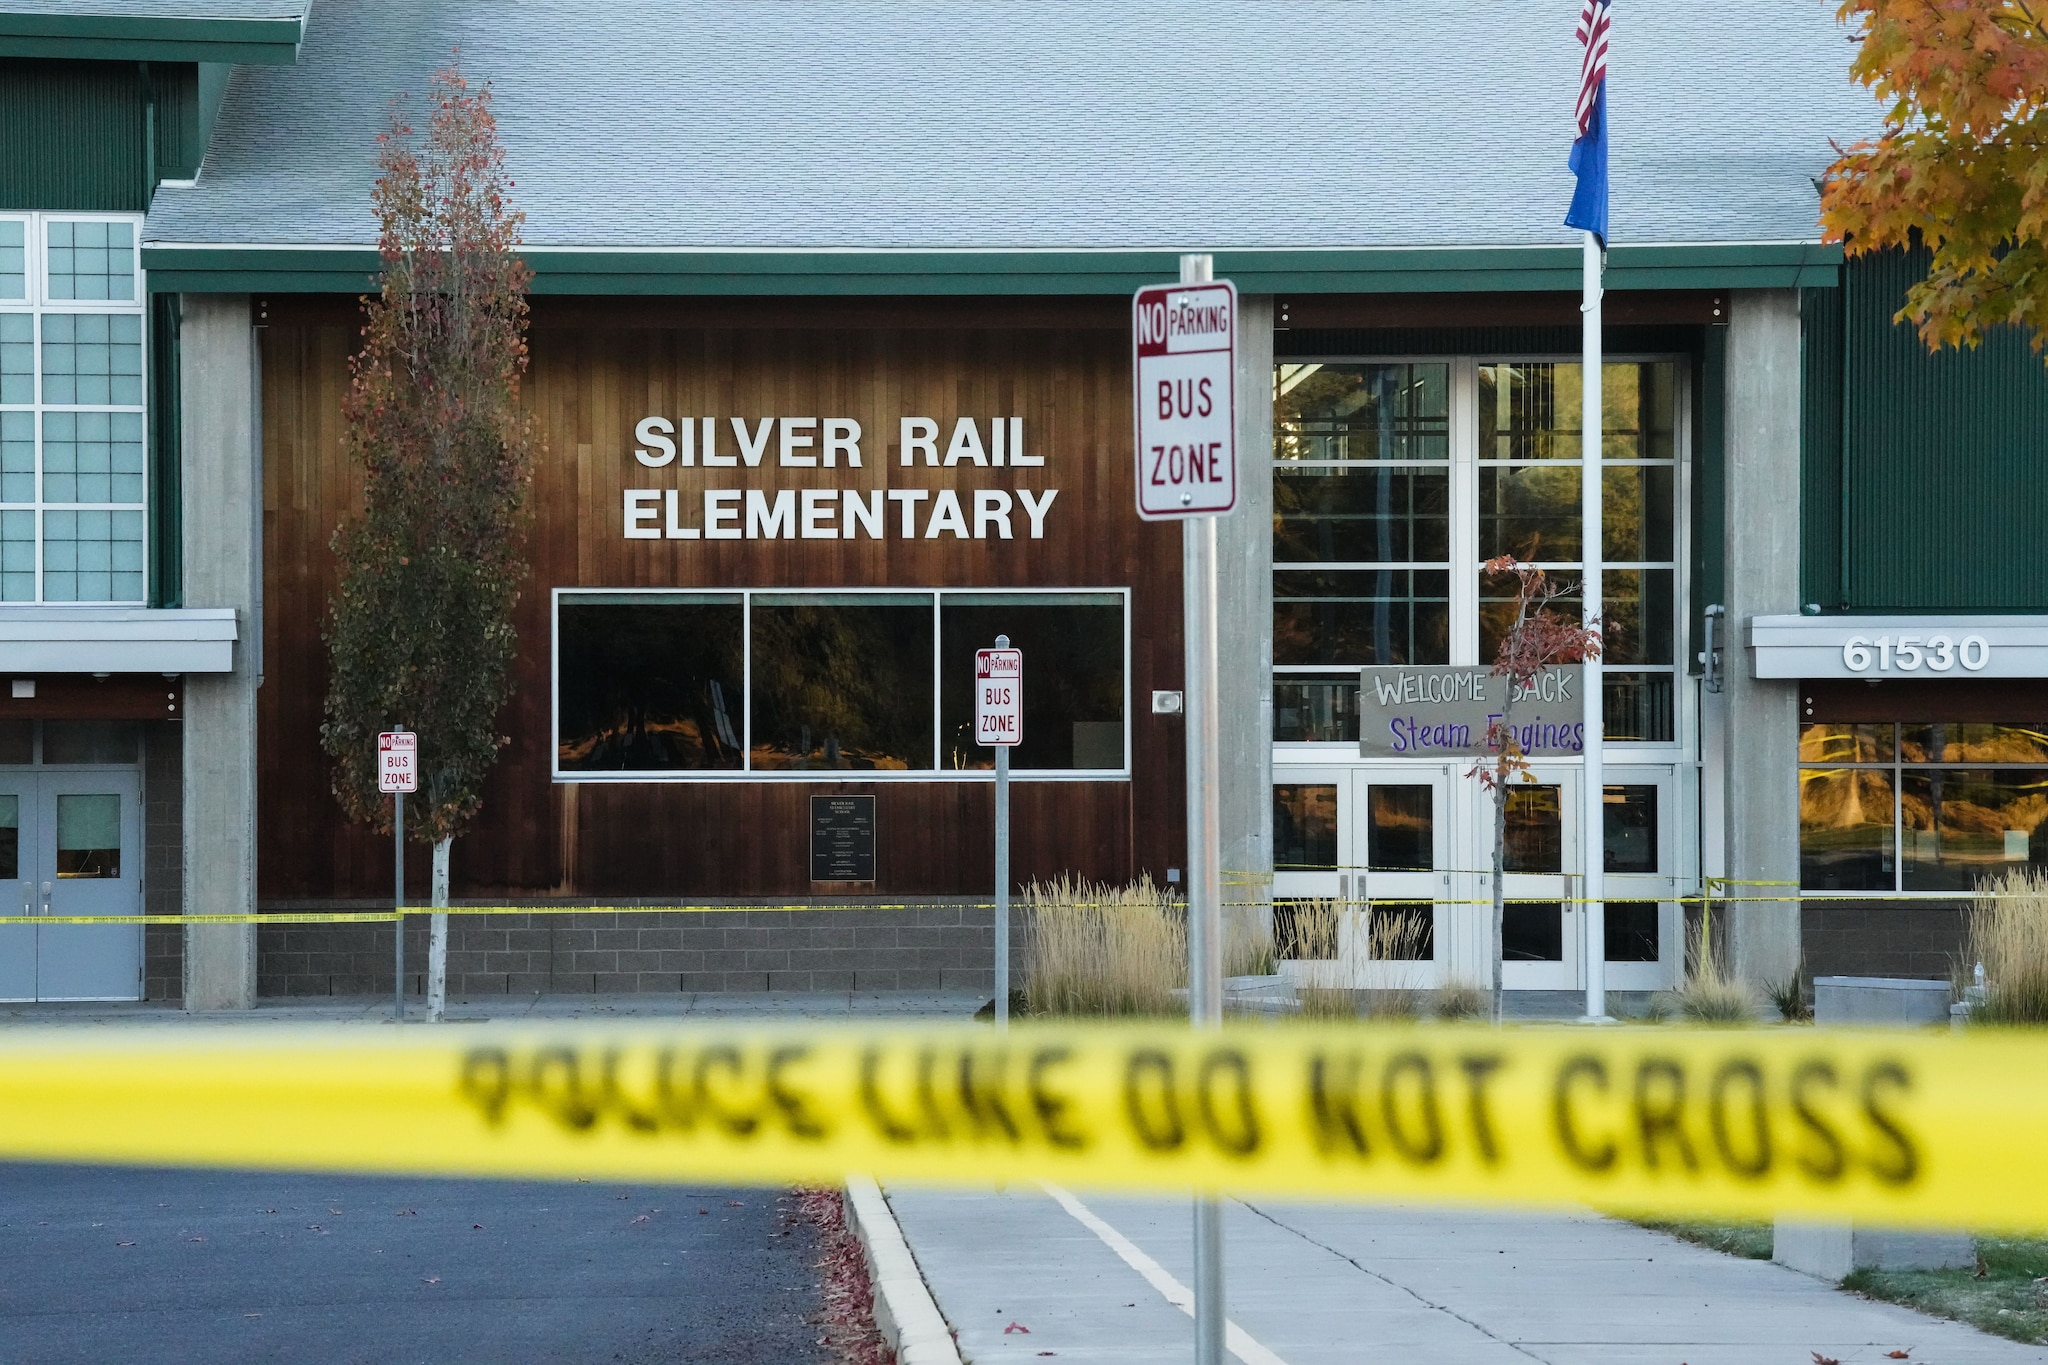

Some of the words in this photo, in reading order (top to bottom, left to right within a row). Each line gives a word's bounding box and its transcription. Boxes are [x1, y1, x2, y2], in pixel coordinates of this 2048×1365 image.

[1138, 302, 1166, 345] NO
[1169, 305, 1228, 336] PARKING
[1158, 377, 1213, 421] BUS
[634, 416, 862, 468] SILVER
[900, 416, 1045, 467] RAIL
[1150, 441, 1223, 486] ZONE
[623, 489, 1059, 540] ELEMENTARY
[978, 656, 990, 674] NO
[991, 659, 1018, 671] PARKING
[1843, 634, 1991, 672] 61530
[985, 688, 1011, 705] BUS
[1374, 671, 1487, 706] WELCOME
[380, 736, 391, 748] NO
[392, 738, 414, 746] PARKING
[982, 715, 1015, 732] ZONE
[1389, 715, 1472, 752] Steam
[384, 773, 412, 784] ZONE
[387, 756, 408, 767] BUS
[458, 1044, 832, 1140] POLICE
[856, 1044, 1090, 1150] LINE
[1122, 1047, 1262, 1156] DO
[1302, 1049, 1506, 1168] NOT
[1550, 1053, 1922, 1188] CROSS
